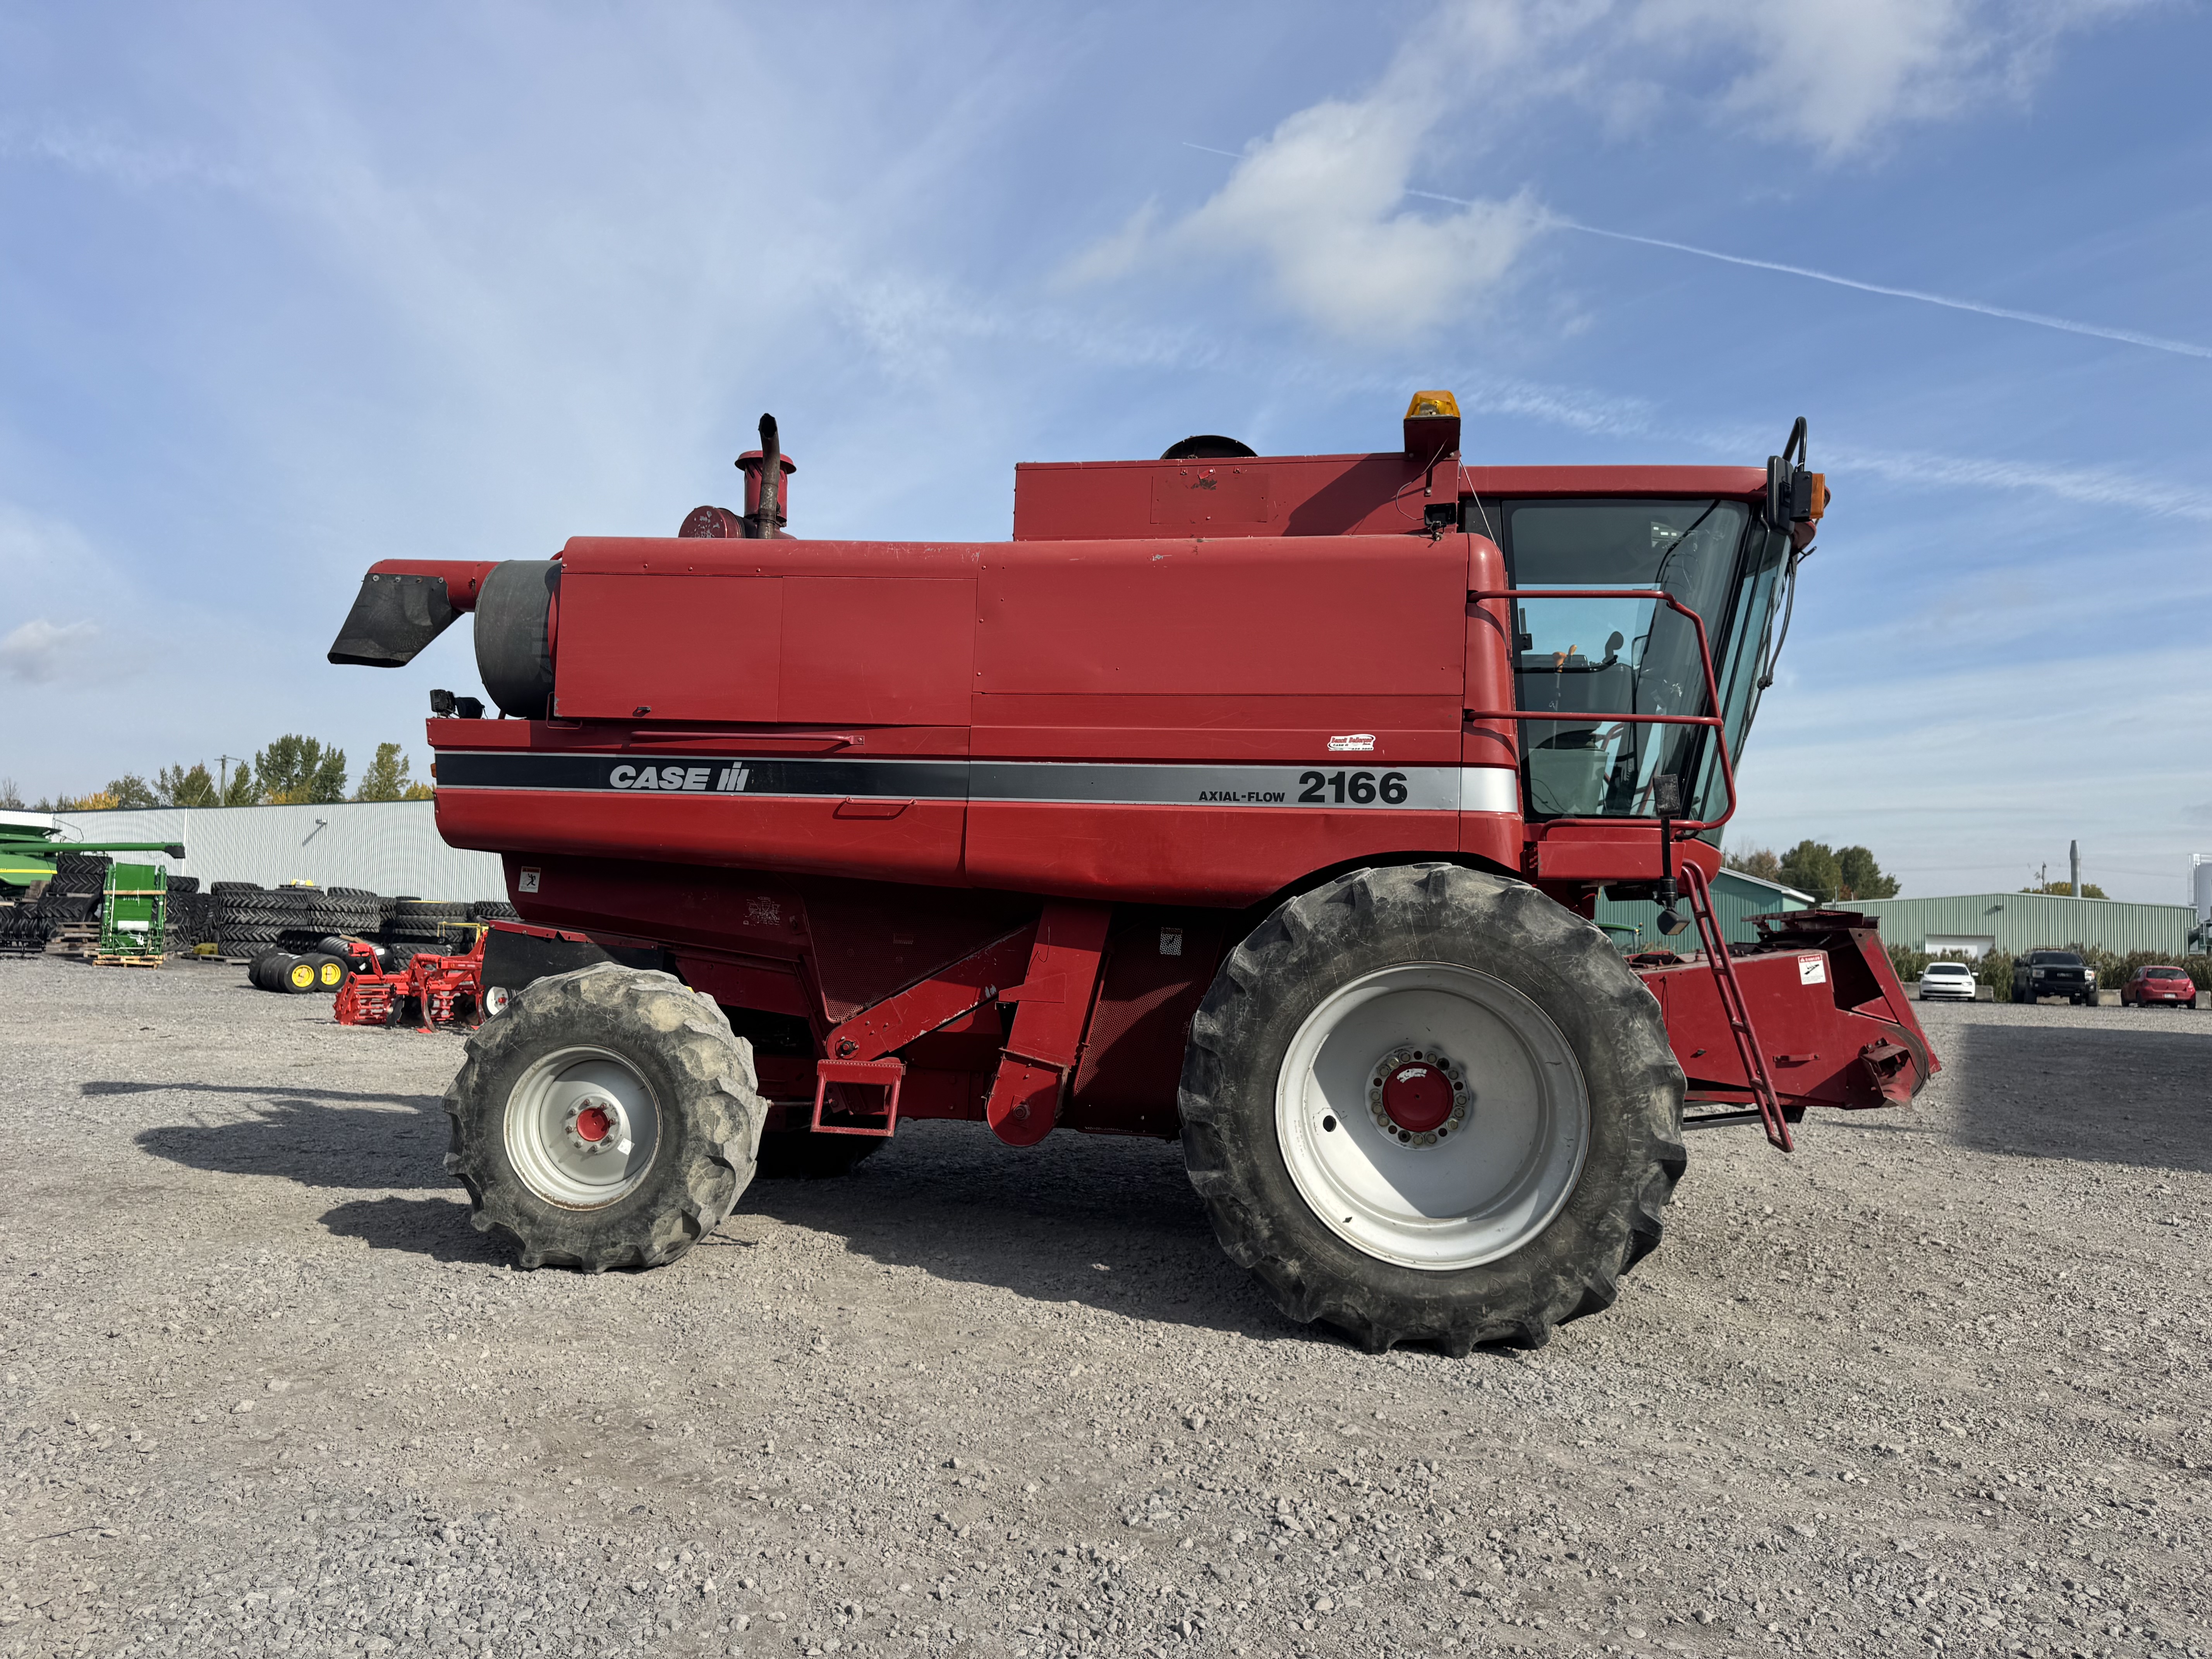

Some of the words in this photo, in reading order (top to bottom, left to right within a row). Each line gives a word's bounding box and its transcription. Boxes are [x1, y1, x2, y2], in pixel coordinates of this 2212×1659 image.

[610, 765, 711, 790] CASE
[1199, 791, 1285, 802] AXIAL-FLOW
[1298, 771, 1407, 804] 2166
[1568, 1164, 1596, 1215] CHAMPION
